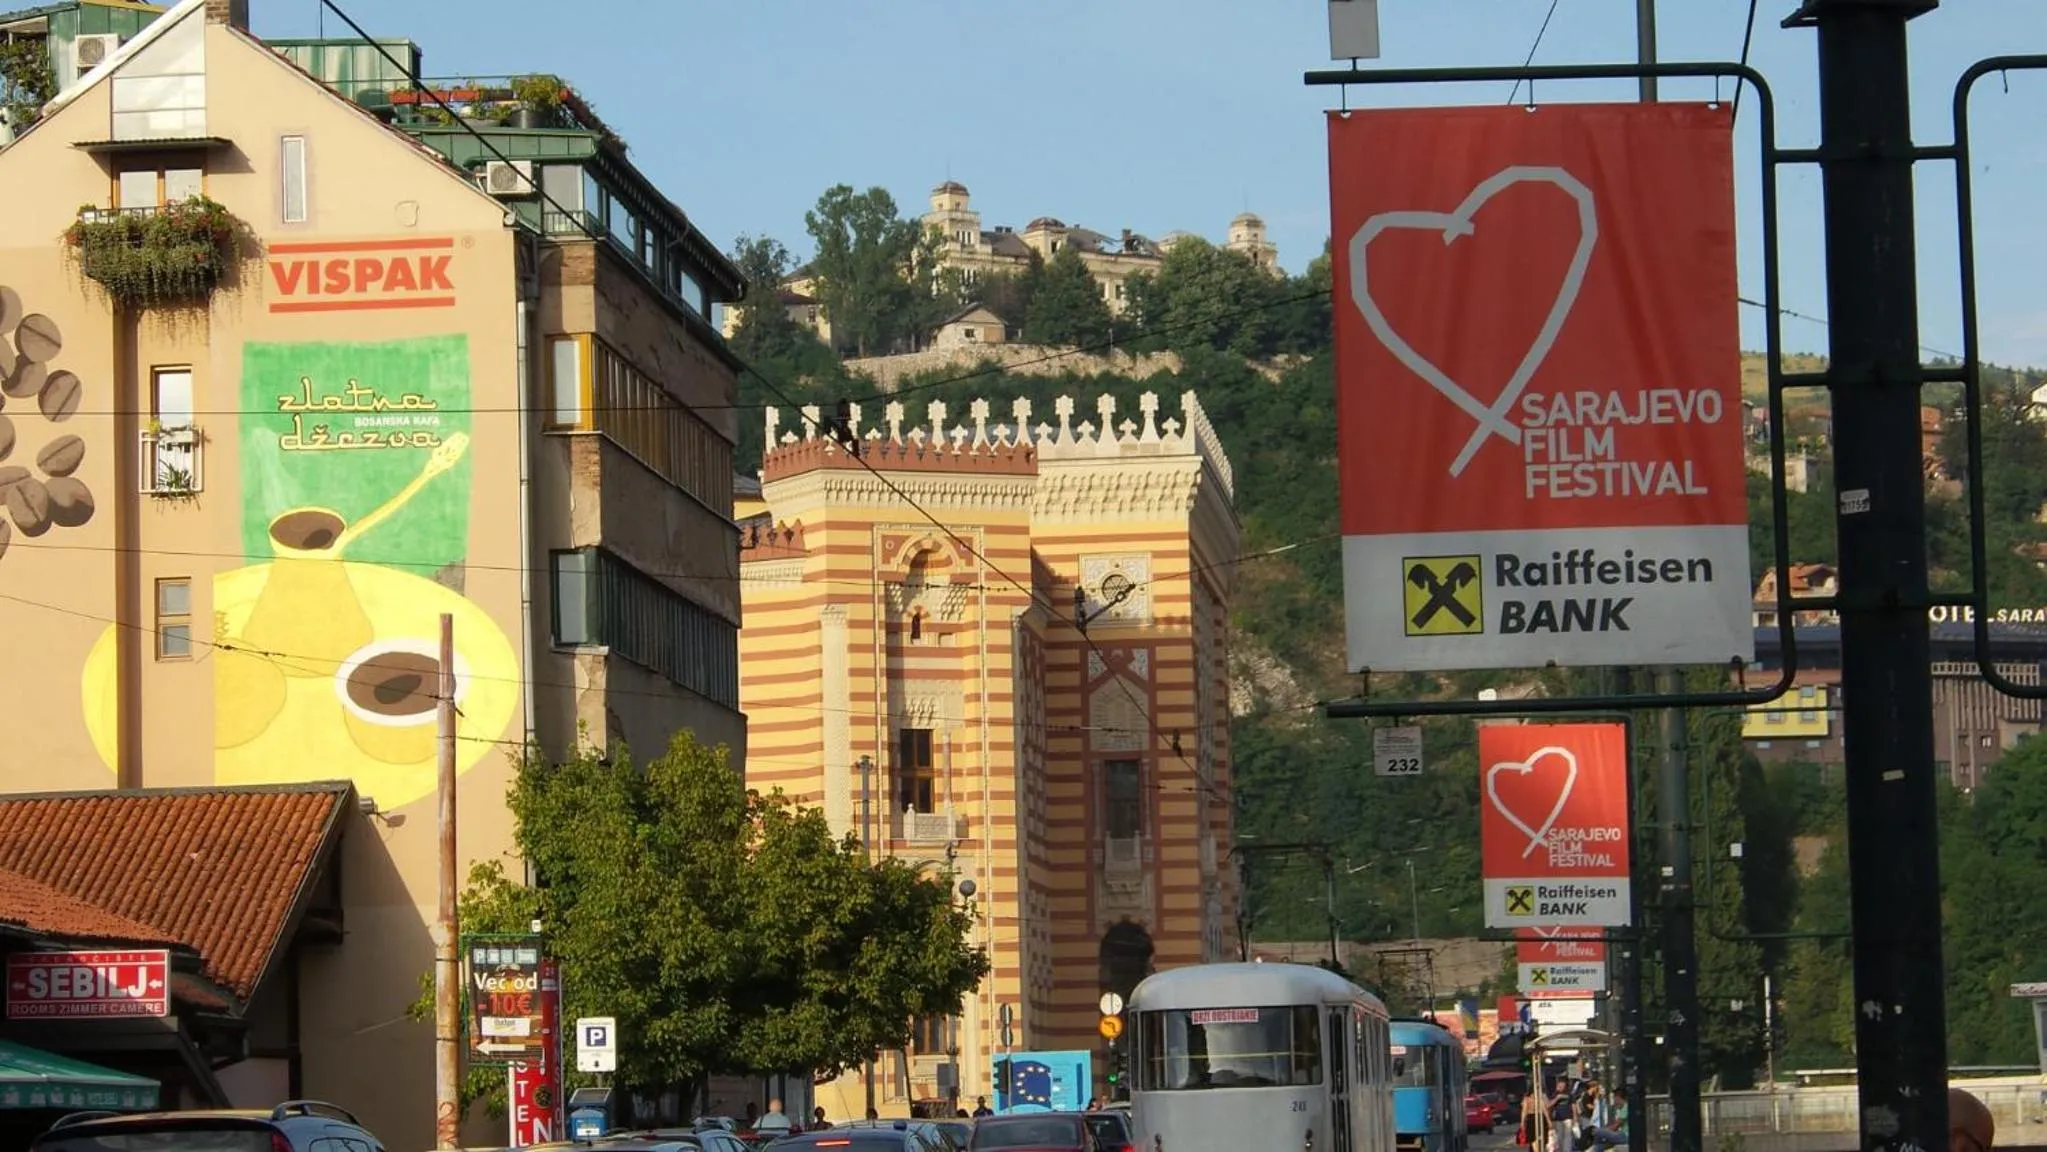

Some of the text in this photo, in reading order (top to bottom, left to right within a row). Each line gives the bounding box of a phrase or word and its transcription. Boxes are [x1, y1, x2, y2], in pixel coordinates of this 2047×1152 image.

[268, 255, 455, 296] VISPAK
[278, 376, 437, 412] zlatna
[1521, 389, 1723, 427] SARAJEVO
[354, 416, 410, 427] BOSANSKA
[1524, 427, 1616, 463] FILM
[1525, 460, 1709, 499] FESTIVAL
[1495, 549, 1713, 588] Raiffeisen
[1499, 597, 1635, 635] BANK
[1387, 758, 1419, 772] 232
[1548, 827, 1621, 841] SARAJEVO
[1548, 841, 1583, 855] FILM
[1548, 853, 1616, 868] FESTIVAL
[1538, 885, 1617, 899] Raiffeisen
[1540, 902, 1588, 916] BANK
[28, 966, 147, 999] SEBILJ
[514, 971, 538, 990] od
[12, 1002, 162, 1015] ROOMS ZIMMER CAMERE
